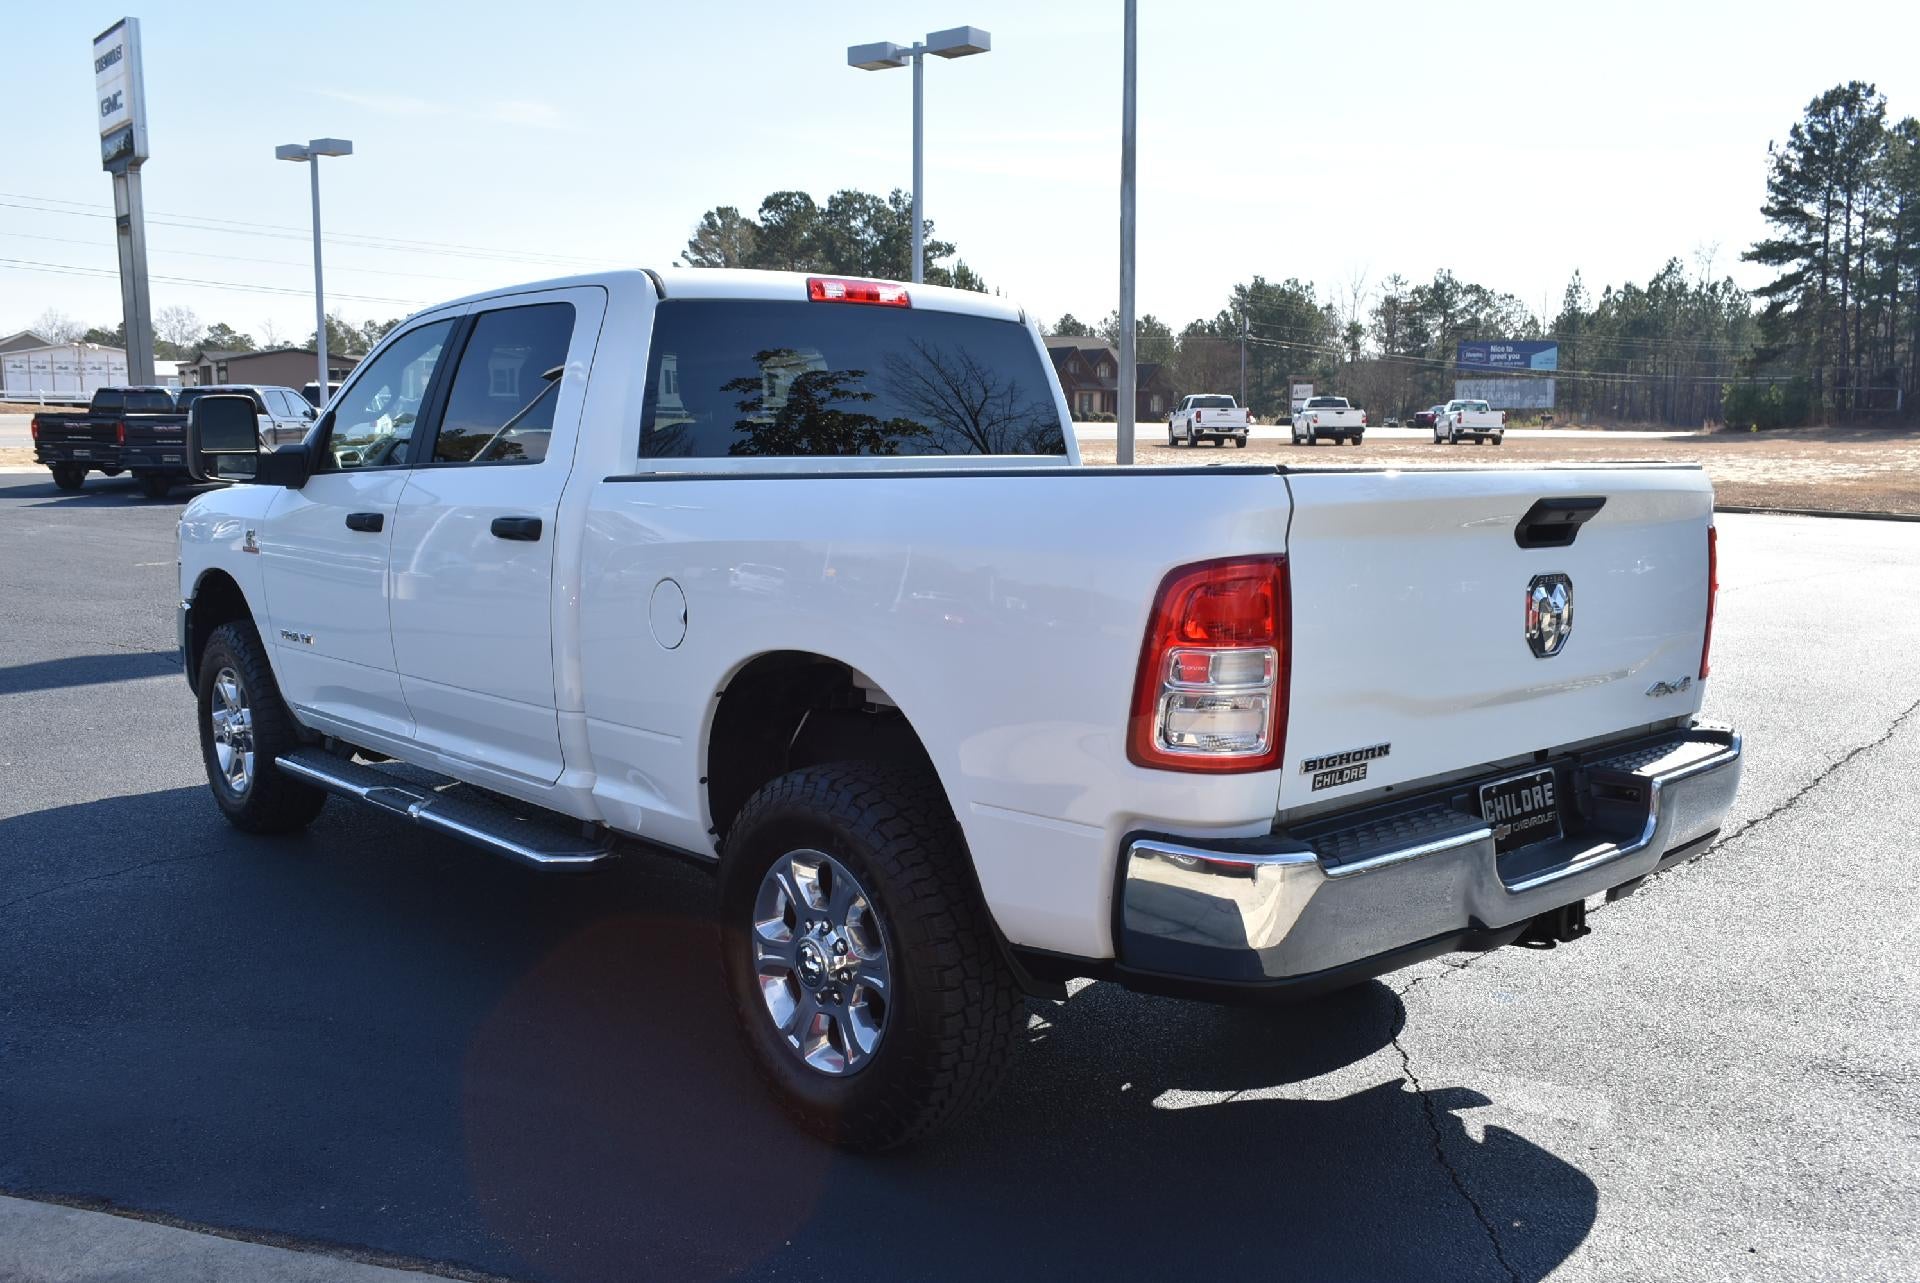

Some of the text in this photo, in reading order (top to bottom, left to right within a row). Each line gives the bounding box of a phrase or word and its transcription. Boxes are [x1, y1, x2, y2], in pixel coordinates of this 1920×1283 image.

[101, 90, 123, 117] GMC
[1490, 345, 1514, 353] Nice to
[1490, 353, 1507, 361] greet
[1508, 353, 1521, 361] you
[1314, 767, 1366, 789] CHILDRE
[1485, 783, 1554, 822] CHILDRE
